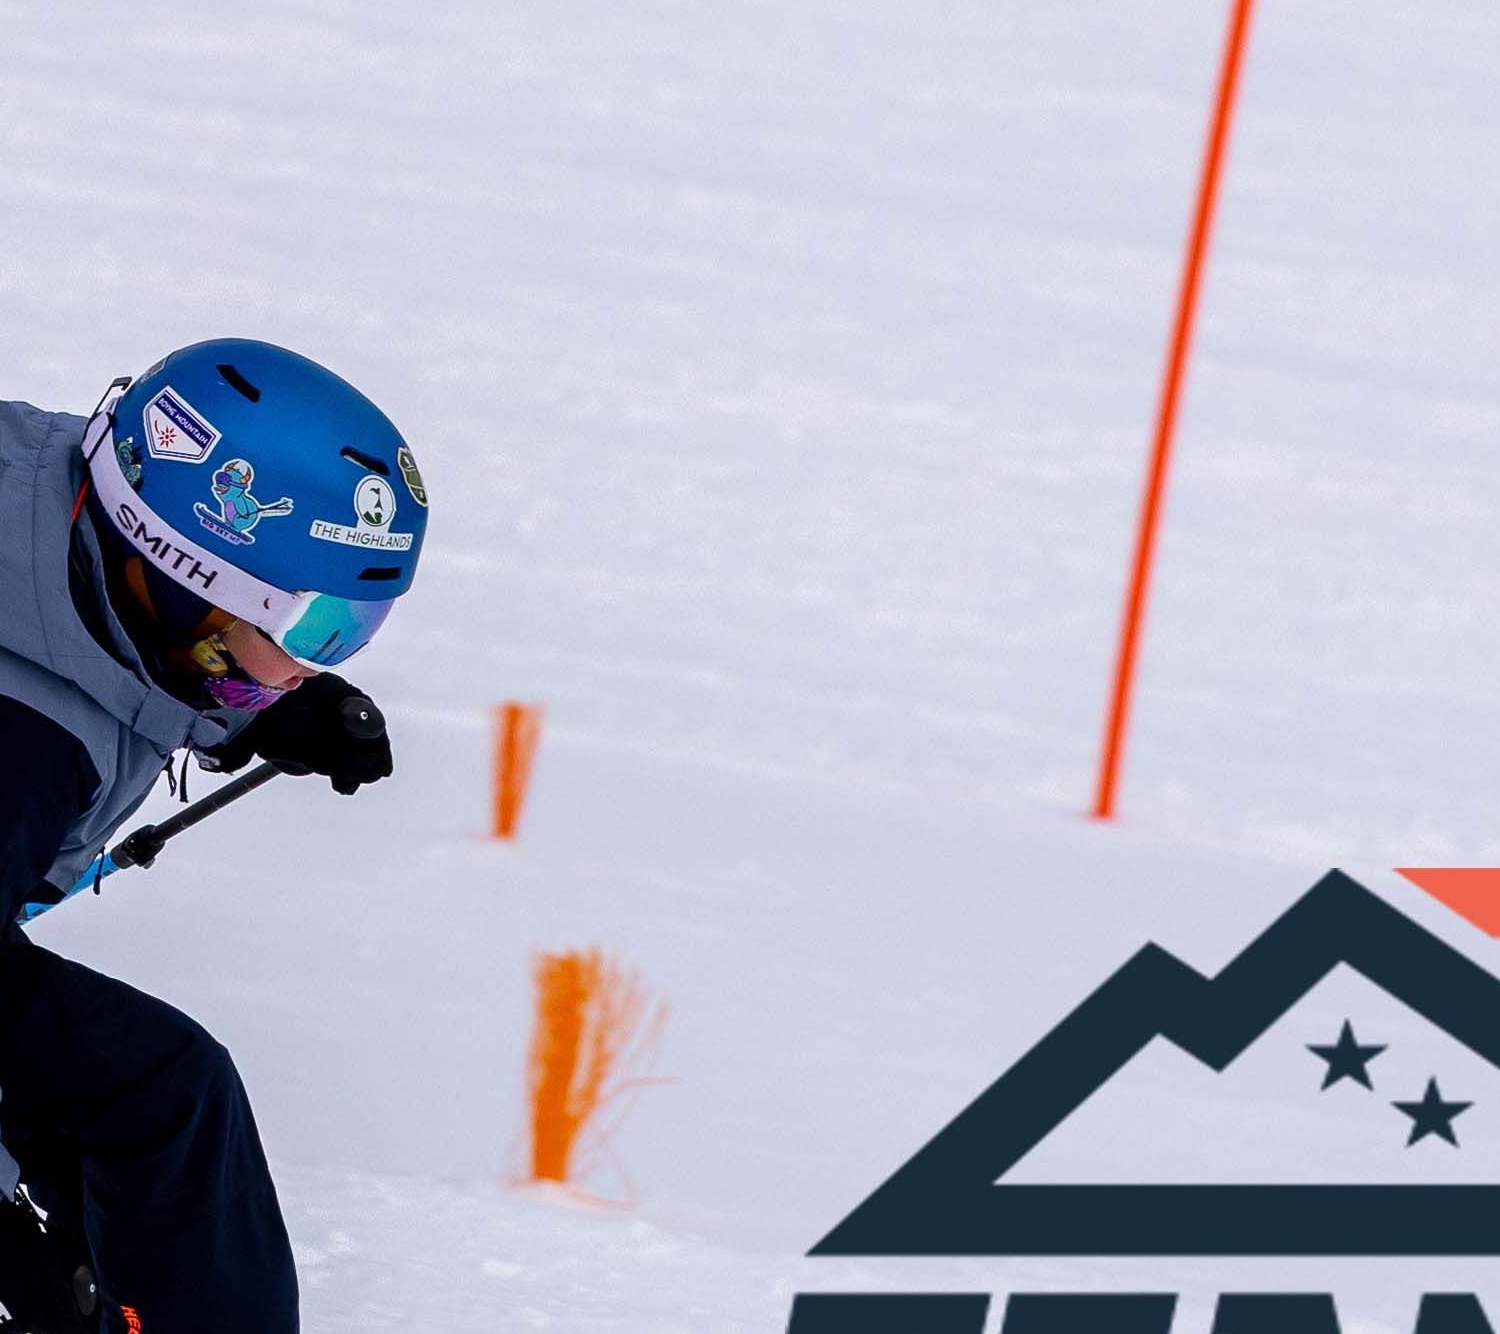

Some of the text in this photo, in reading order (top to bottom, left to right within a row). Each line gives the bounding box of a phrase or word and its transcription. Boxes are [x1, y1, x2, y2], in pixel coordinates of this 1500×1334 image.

[175, 414, 209, 445] MOUNTAIN
[116, 503, 218, 589] SMITH
[314, 522, 411, 549] THE HIGHLANDS
